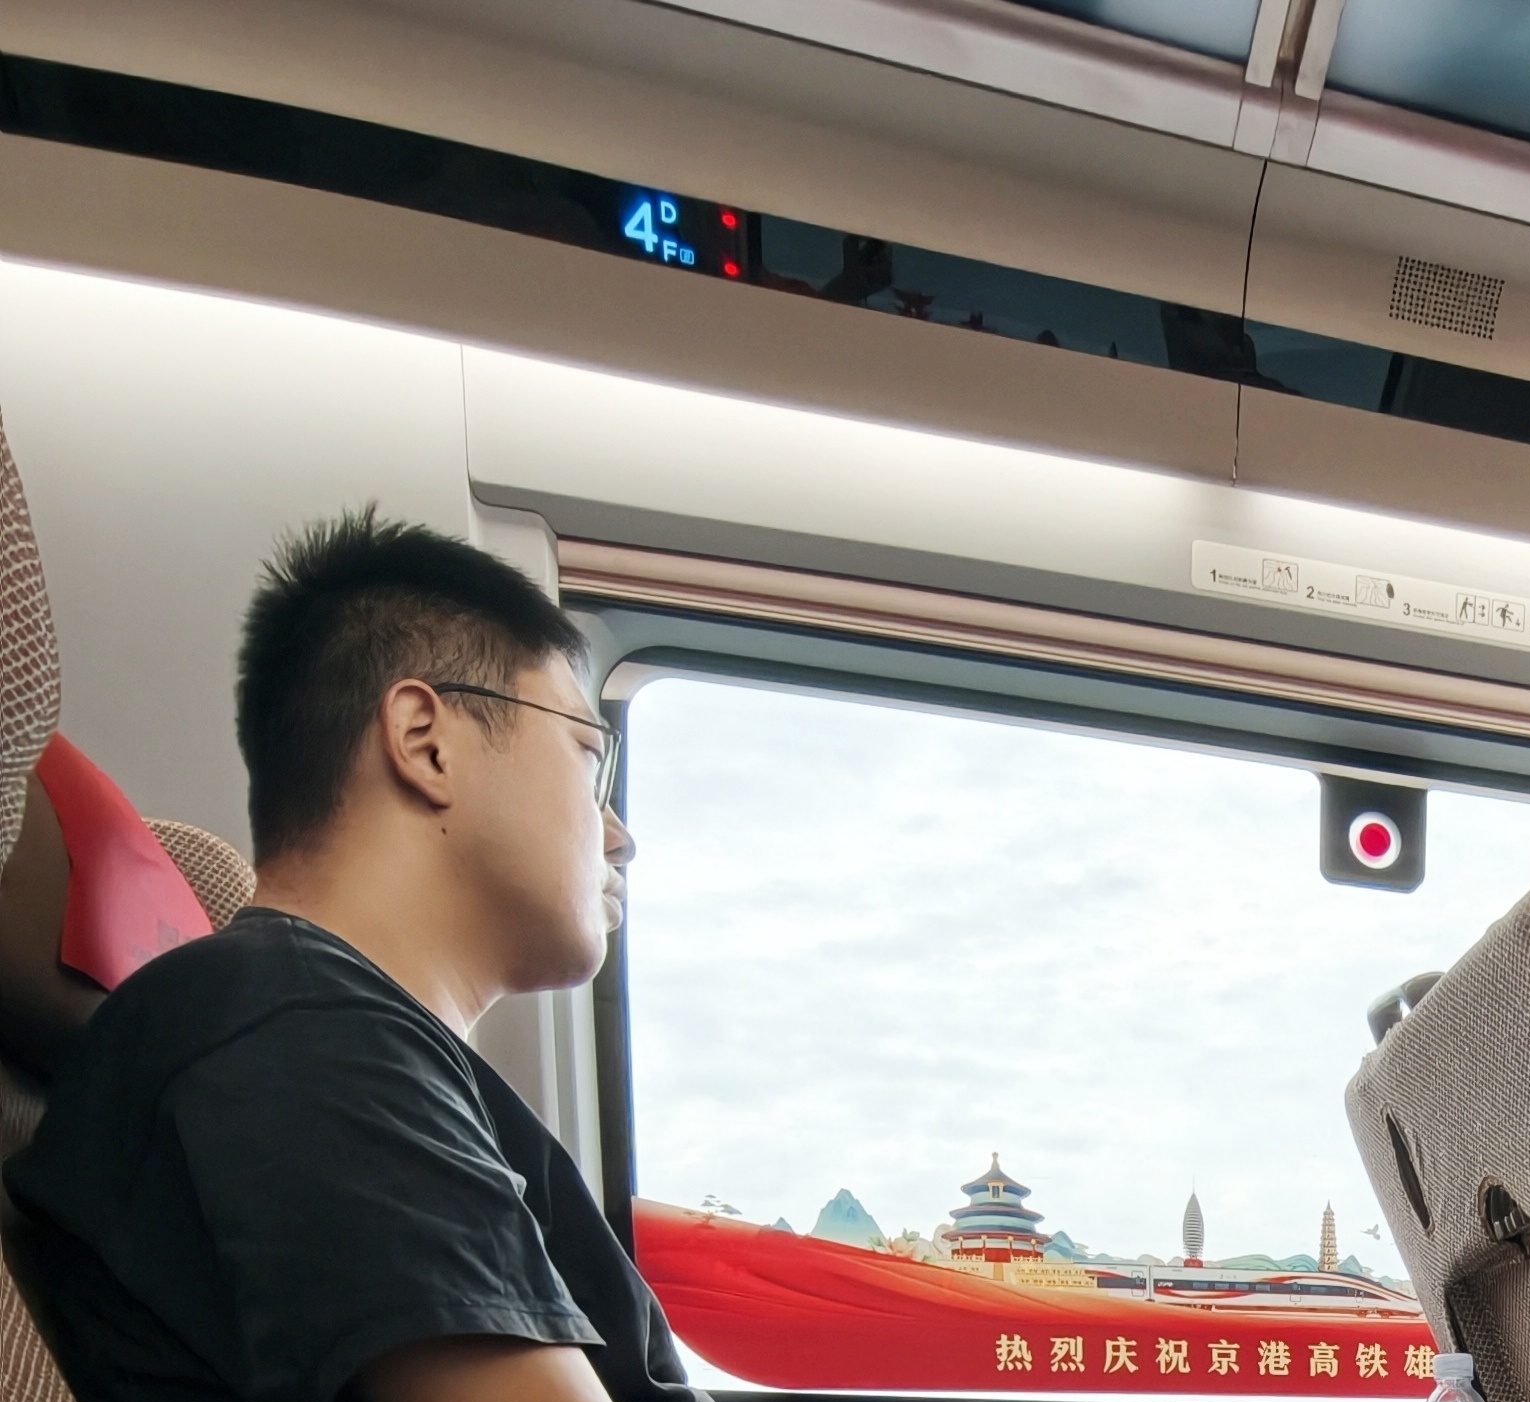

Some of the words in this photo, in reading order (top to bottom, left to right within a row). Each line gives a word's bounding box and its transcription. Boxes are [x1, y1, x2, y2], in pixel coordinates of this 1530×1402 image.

[624, 201, 658, 253] 4
[661, 201, 677, 223] D
[662, 240, 678, 262] F
[1209, 569, 1217, 583] 1
[1306, 586, 1315, 600] 2
[1402, 603, 1411, 616] 3
[995, 1333, 1437, 1380] 热烈庆祝京港高铁雄
